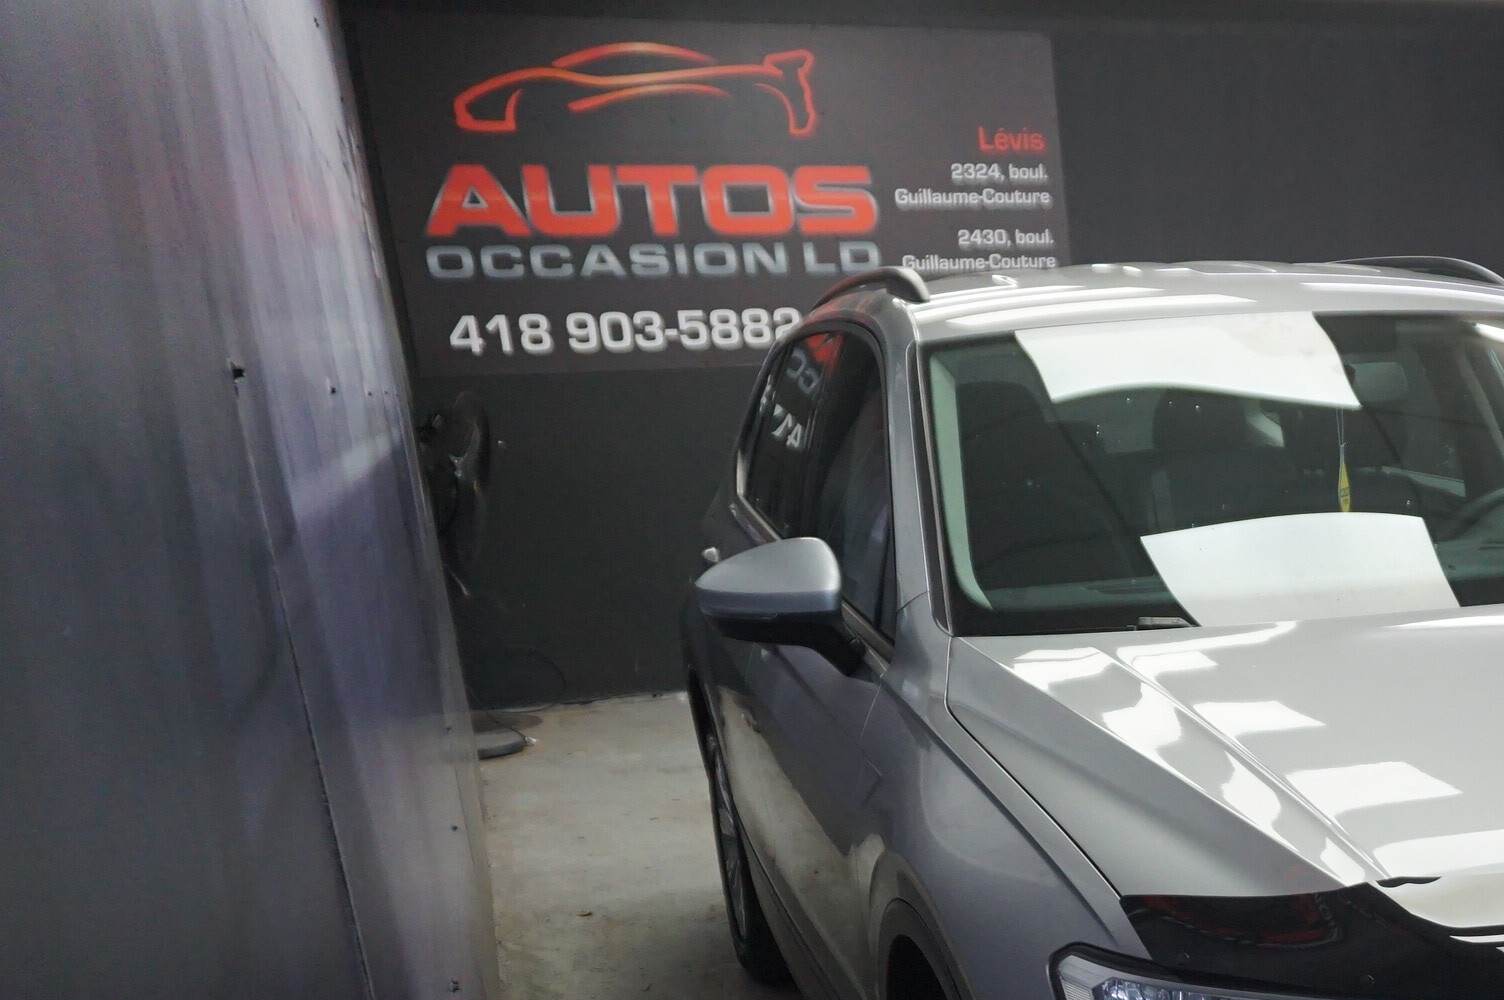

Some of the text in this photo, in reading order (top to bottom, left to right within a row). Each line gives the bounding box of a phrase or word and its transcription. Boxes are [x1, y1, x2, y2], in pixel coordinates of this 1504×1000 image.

[977, 125, 1046, 152] Lévis
[951, 163, 1049, 182] 2324, boul.
[426, 164, 879, 237] AUTOS
[895, 187, 1051, 206] Guillaume-Couture
[958, 228, 1055, 247] 2430, boul.
[425, 241, 881, 279] OCCASION LD
[902, 253, 1057, 271] Guillaume-Couture
[450, 312, 555, 356] 418
